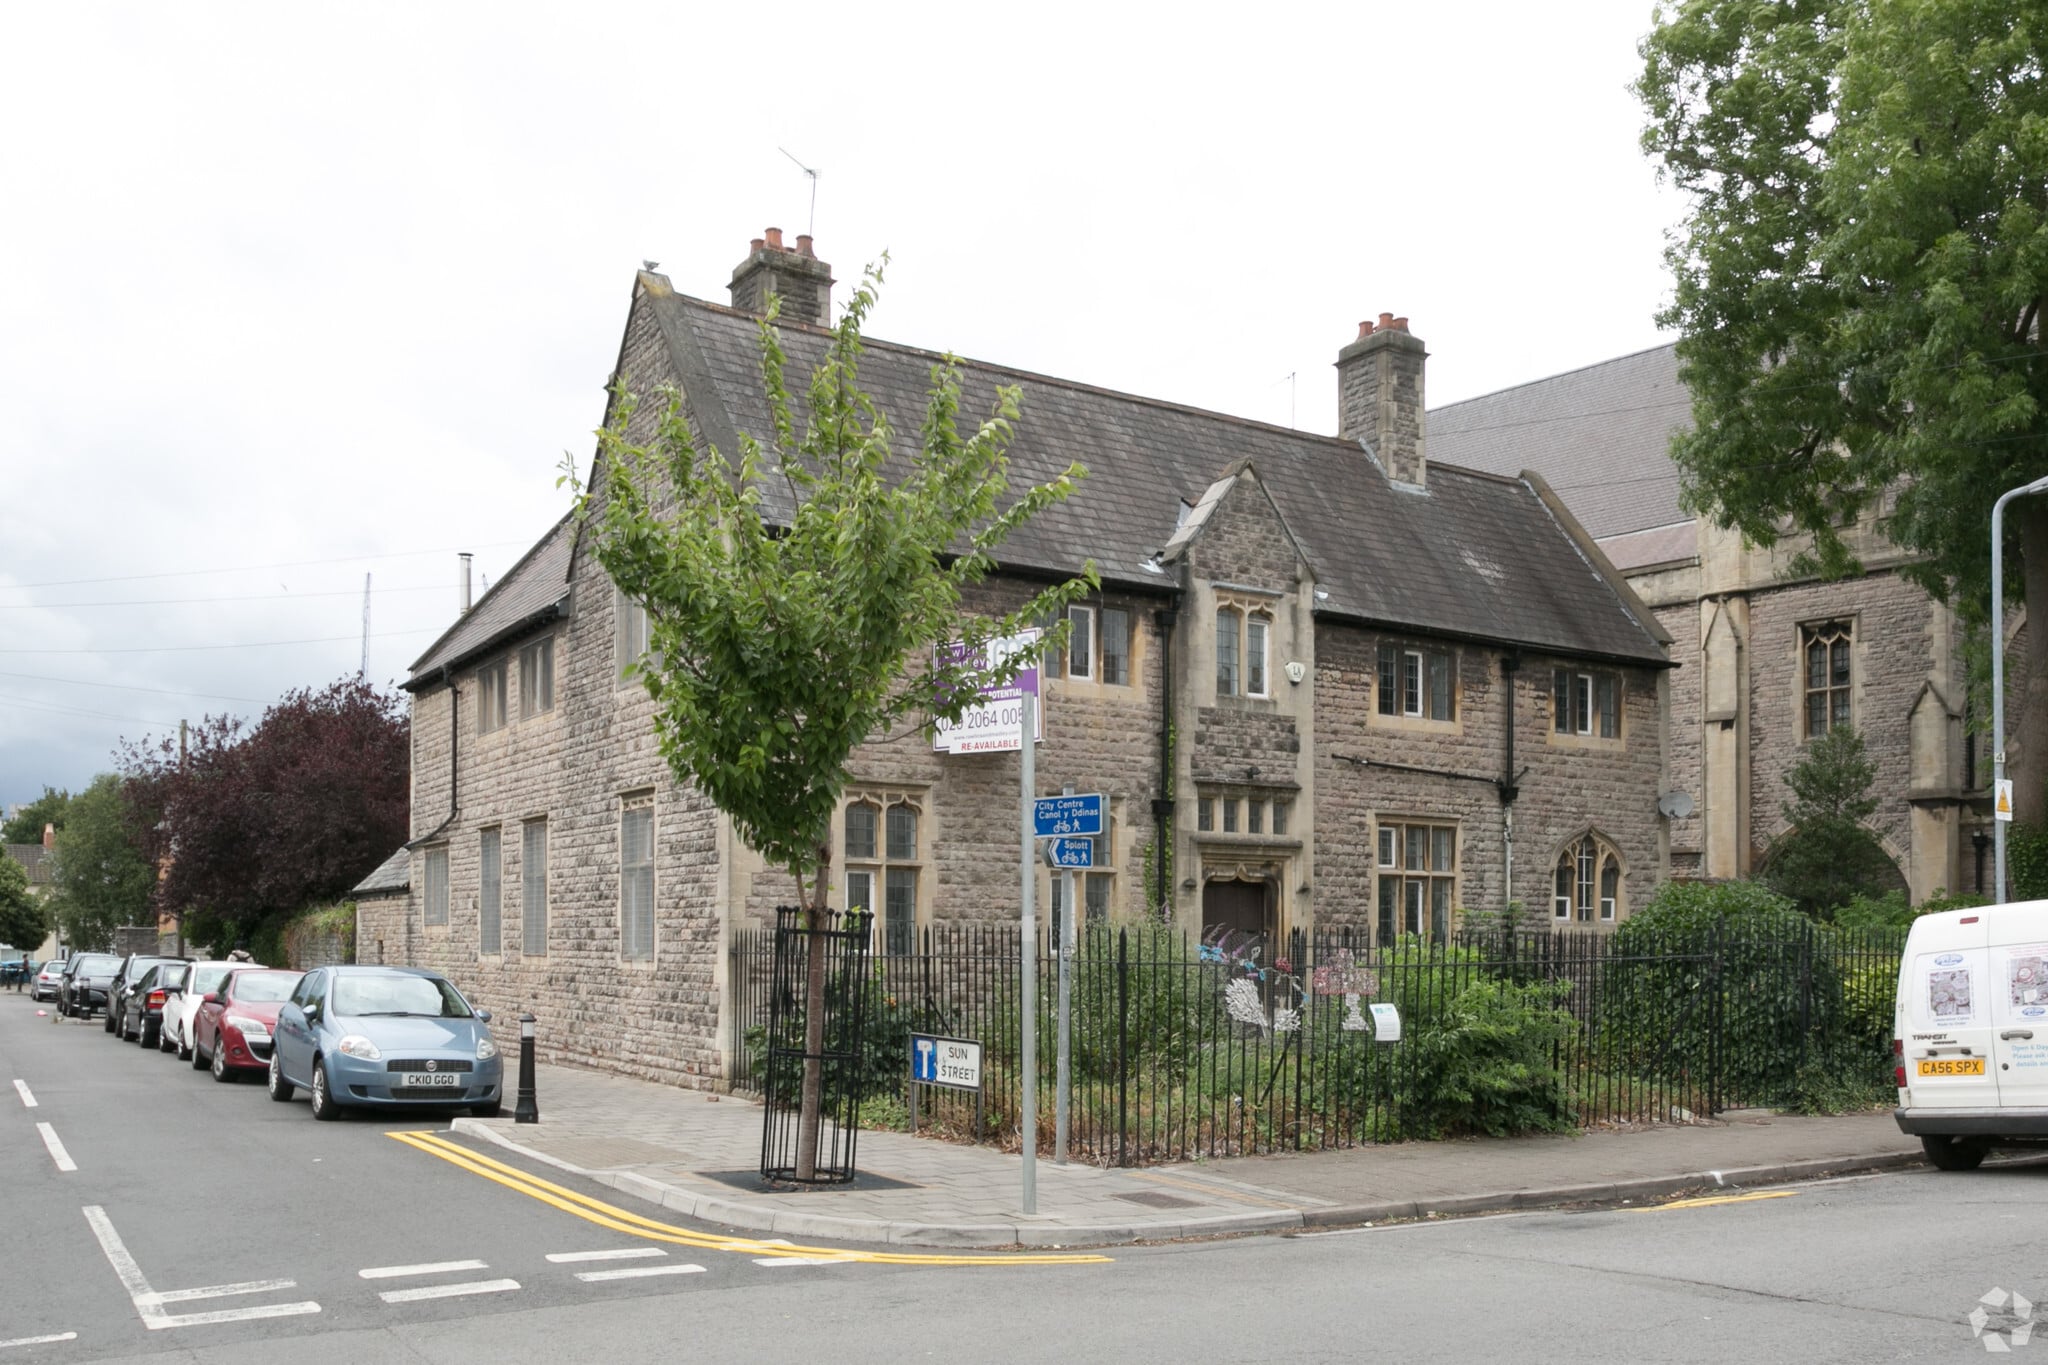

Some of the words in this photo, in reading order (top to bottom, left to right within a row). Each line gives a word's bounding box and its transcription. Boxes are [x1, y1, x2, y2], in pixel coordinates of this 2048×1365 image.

[967, 711, 998, 729] 2064
[1001, 708, 1022, 726] 005
[961, 739, 1019, 751] RE-AVAILABLE
[1038, 802, 1055, 811] City
[1057, 800, 1084, 809] Centre
[1038, 810, 1061, 819] Canol
[1063, 811, 1069, 819] y
[1071, 808, 1099, 817] Ddinas
[1064, 840, 1088, 850] Splott
[1912, 1033, 1948, 1041] TRANSIT
[948, 1046, 968, 1060] SUN
[941, 1065, 976, 1080] STREET
[1922, 1062, 1953, 1074] CA56
[1956, 1061, 1979, 1073] SPX
[408, 1075, 432, 1085] CK10
[434, 1075, 454, 1085] GGO
